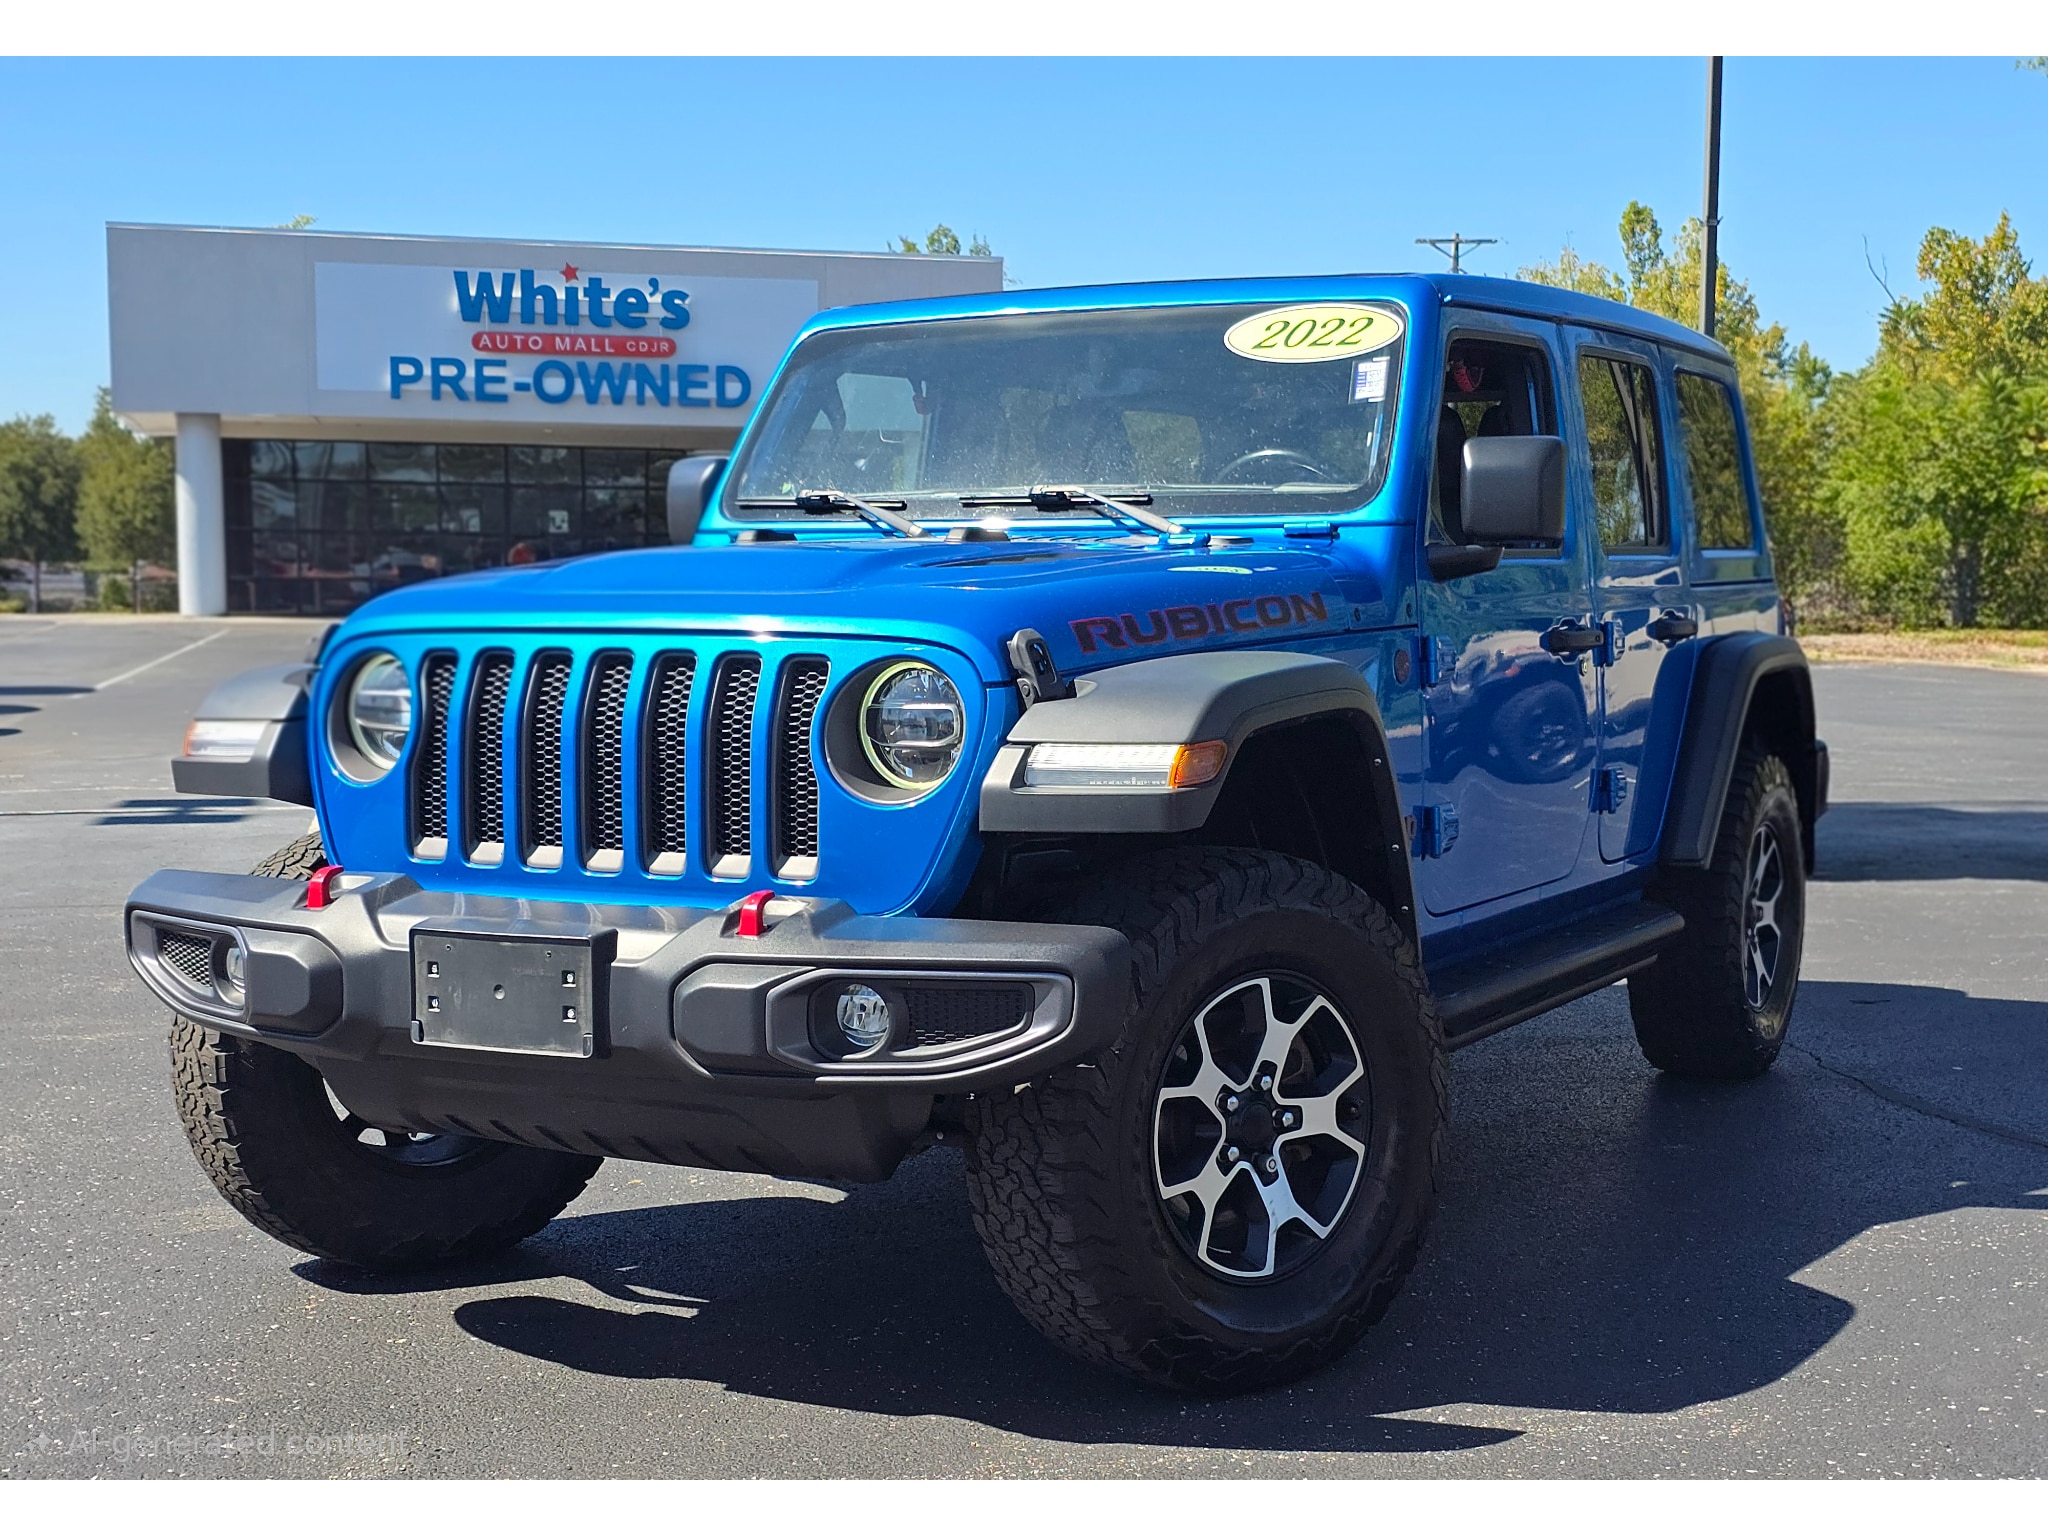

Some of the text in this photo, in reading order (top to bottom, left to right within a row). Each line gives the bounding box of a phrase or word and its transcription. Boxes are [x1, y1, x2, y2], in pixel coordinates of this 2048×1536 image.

[453, 266, 691, 330] White's
[478, 333, 670, 354] AUTO MALL CDJR
[1251, 316, 1374, 350] 2022
[389, 356, 752, 408] PRE-OWNED
[1068, 591, 1329, 654] RUBICON
